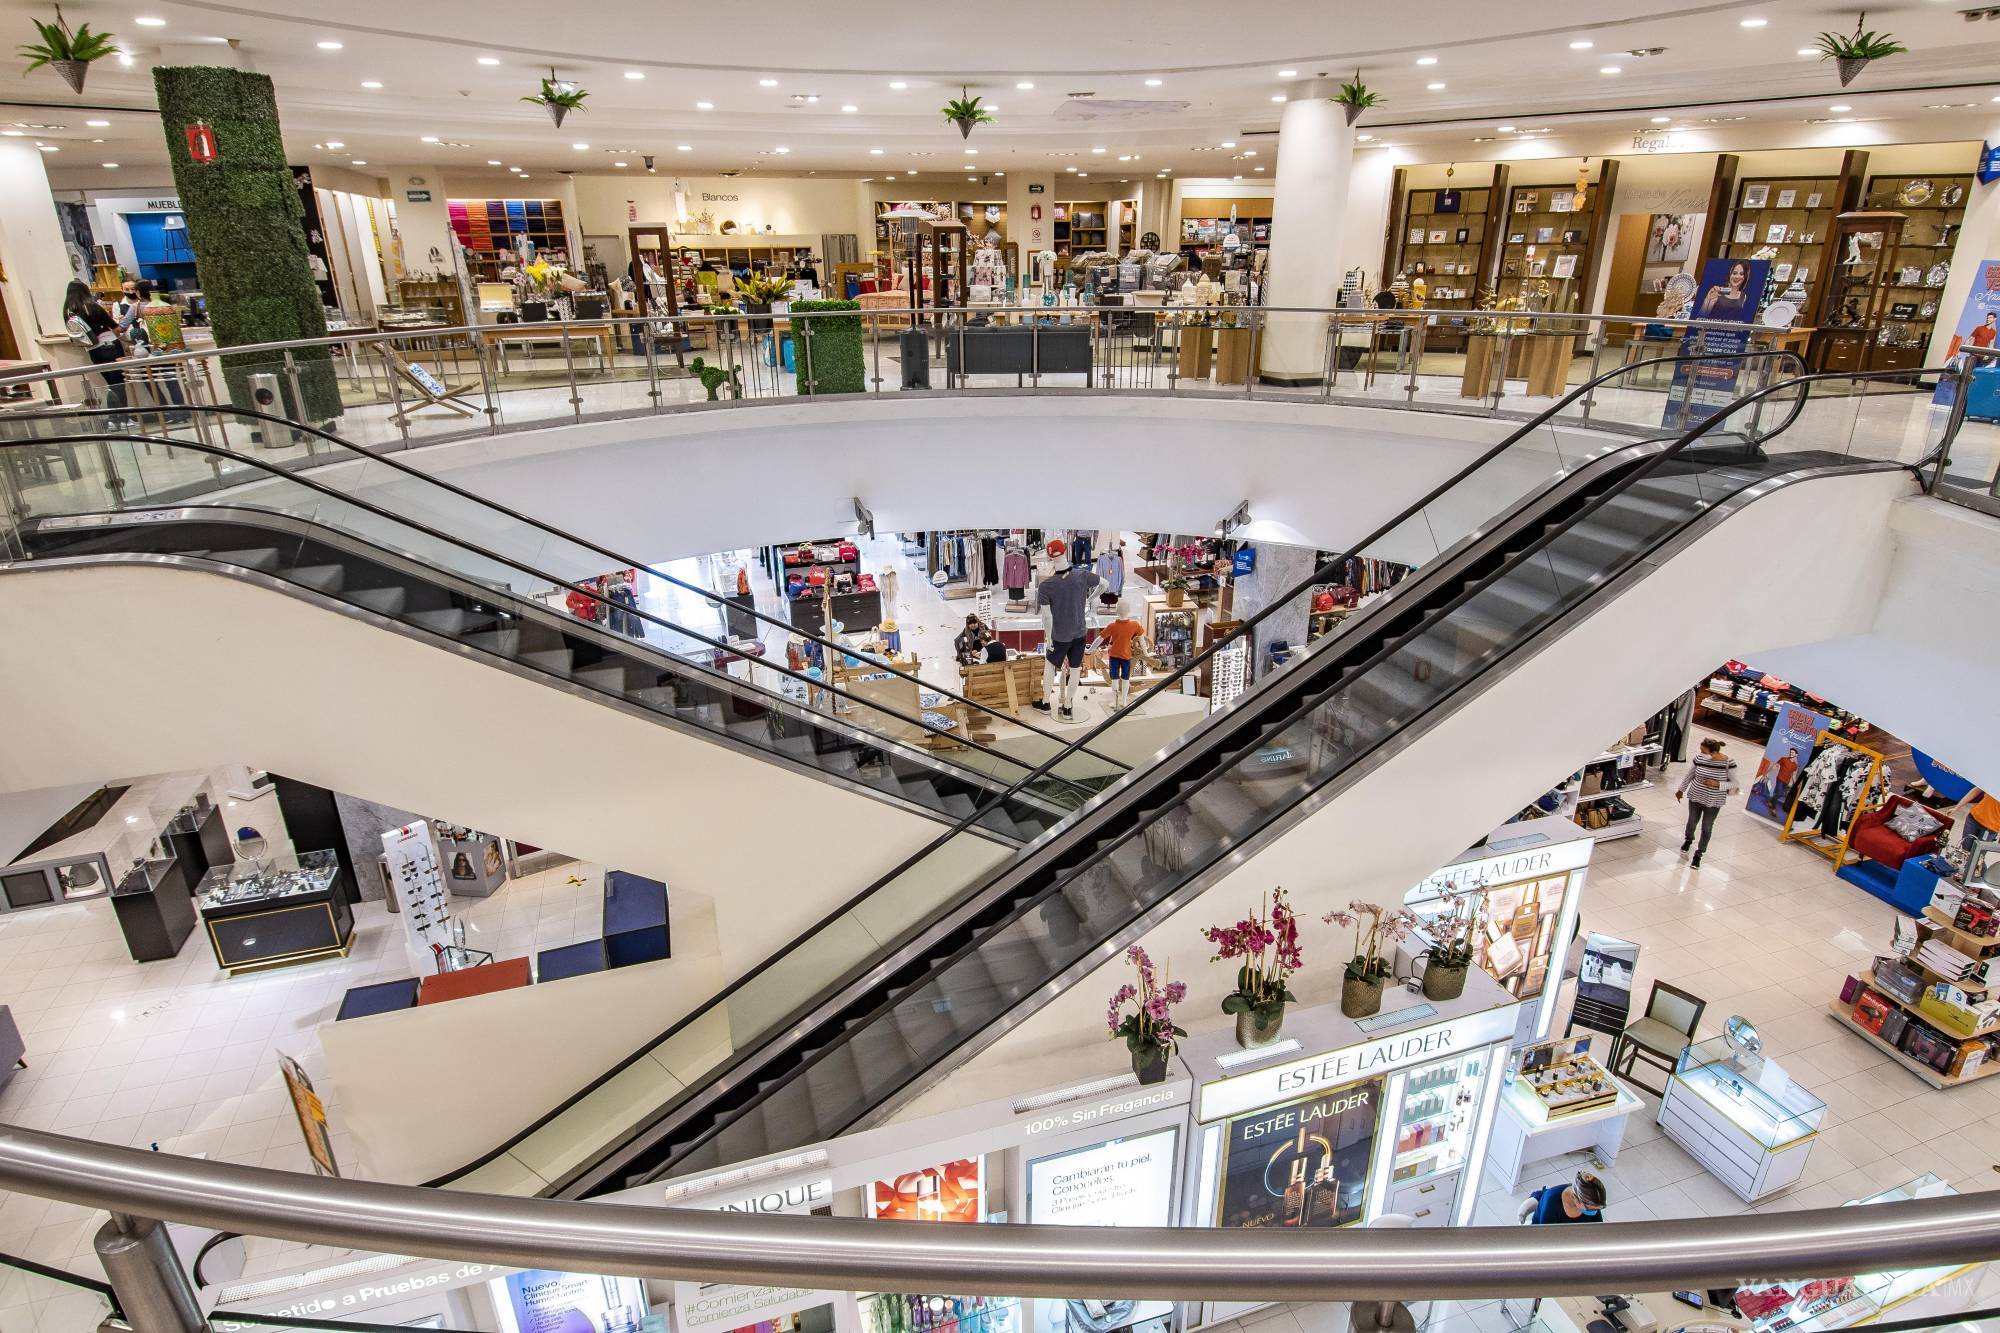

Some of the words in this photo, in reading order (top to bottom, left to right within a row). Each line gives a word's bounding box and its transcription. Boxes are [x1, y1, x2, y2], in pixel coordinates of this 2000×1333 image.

[702, 192, 739, 202] Blancos
[1357, 1029, 1453, 1071] LAUDER
[1024, 1114, 1069, 1136] 100%
[1071, 1108, 1097, 1124] Sin
[1099, 1088, 1175, 1118] Fragancia
[1299, 1092, 1370, 1124] LAUDER
[222, 1297, 337, 1332] Setido
[342, 1294, 357, 1307] a
[359, 1272, 451, 1302] Pruebas
[455, 1264, 482, 1279] de
